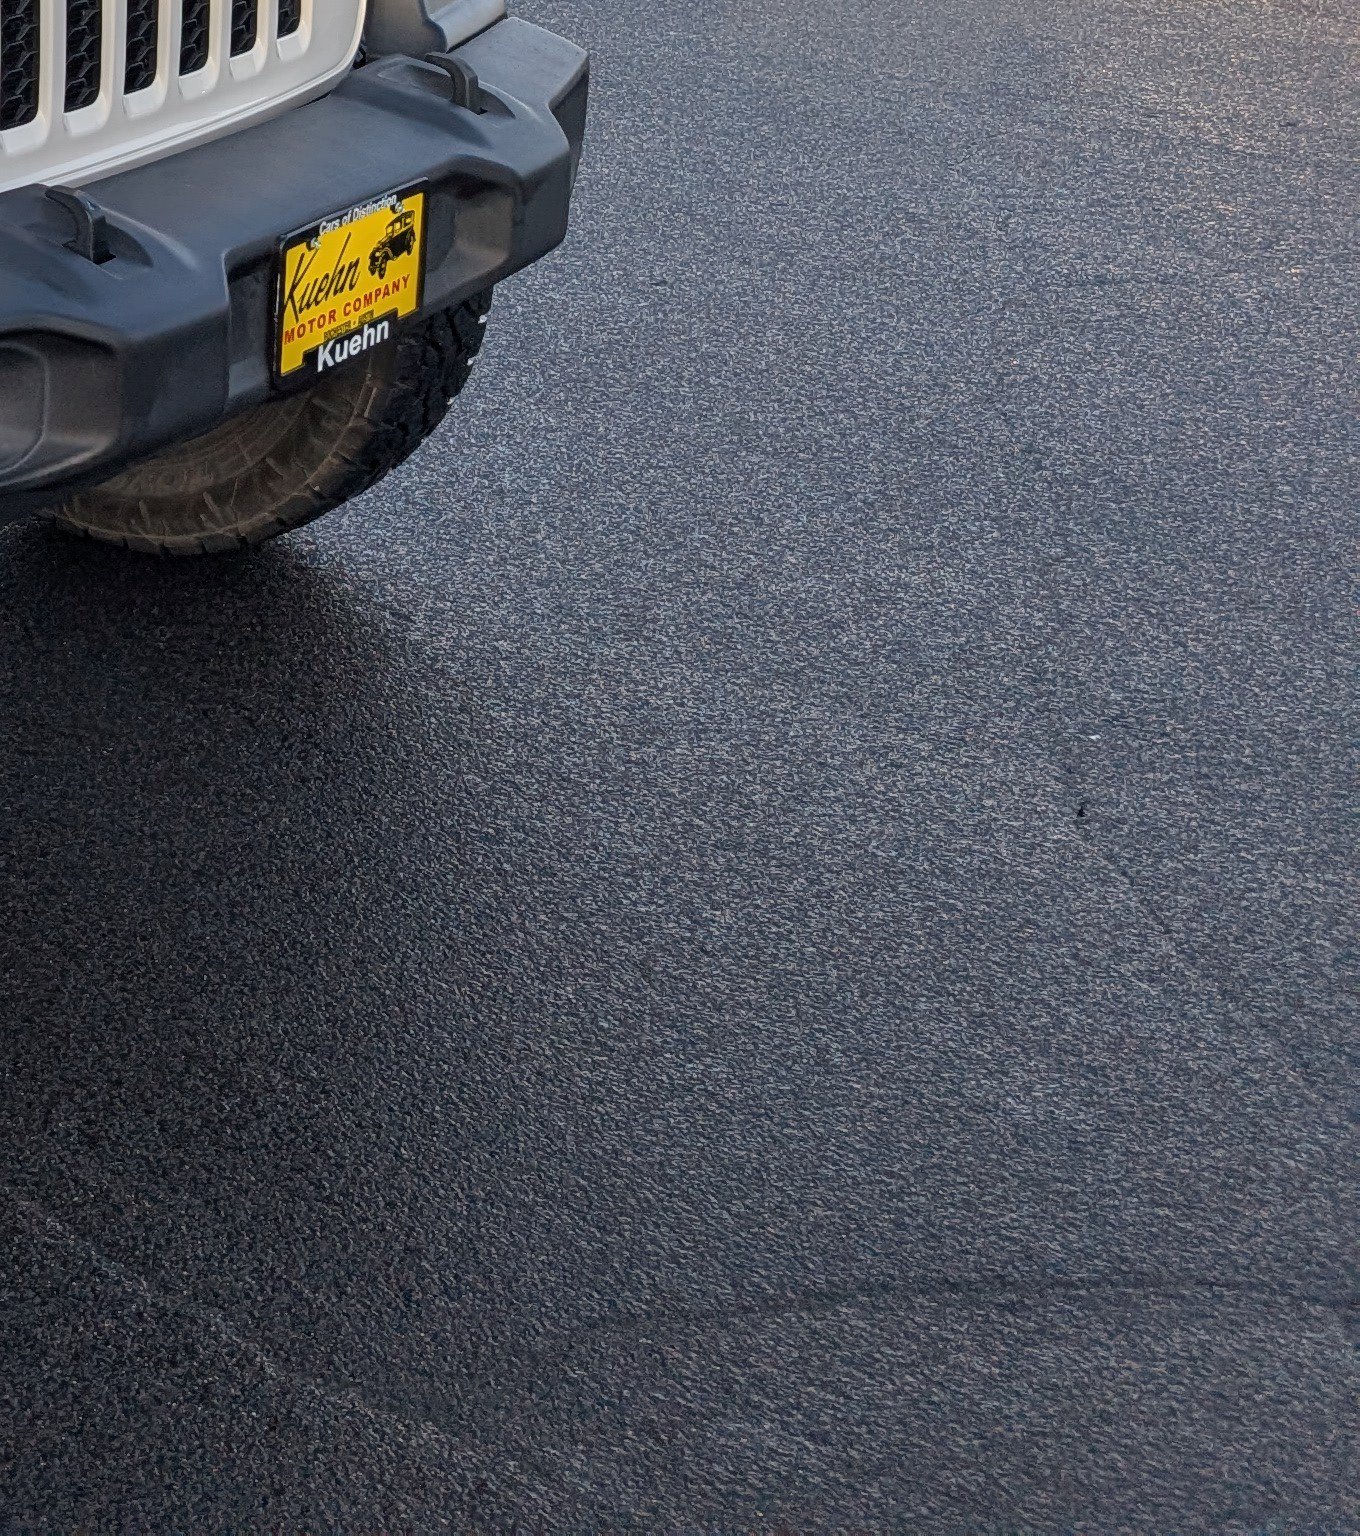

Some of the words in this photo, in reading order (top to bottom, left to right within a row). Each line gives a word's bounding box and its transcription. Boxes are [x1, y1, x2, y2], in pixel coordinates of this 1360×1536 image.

[319, 219, 340, 236] Cars
[342, 210, 353, 226] of
[353, 194, 397, 222] Distinction
[283, 231, 360, 323] Kuehn
[284, 307, 337, 345] MOTOR
[343, 273, 410, 317] COMPANY
[317, 320, 389, 373] Kuehn
